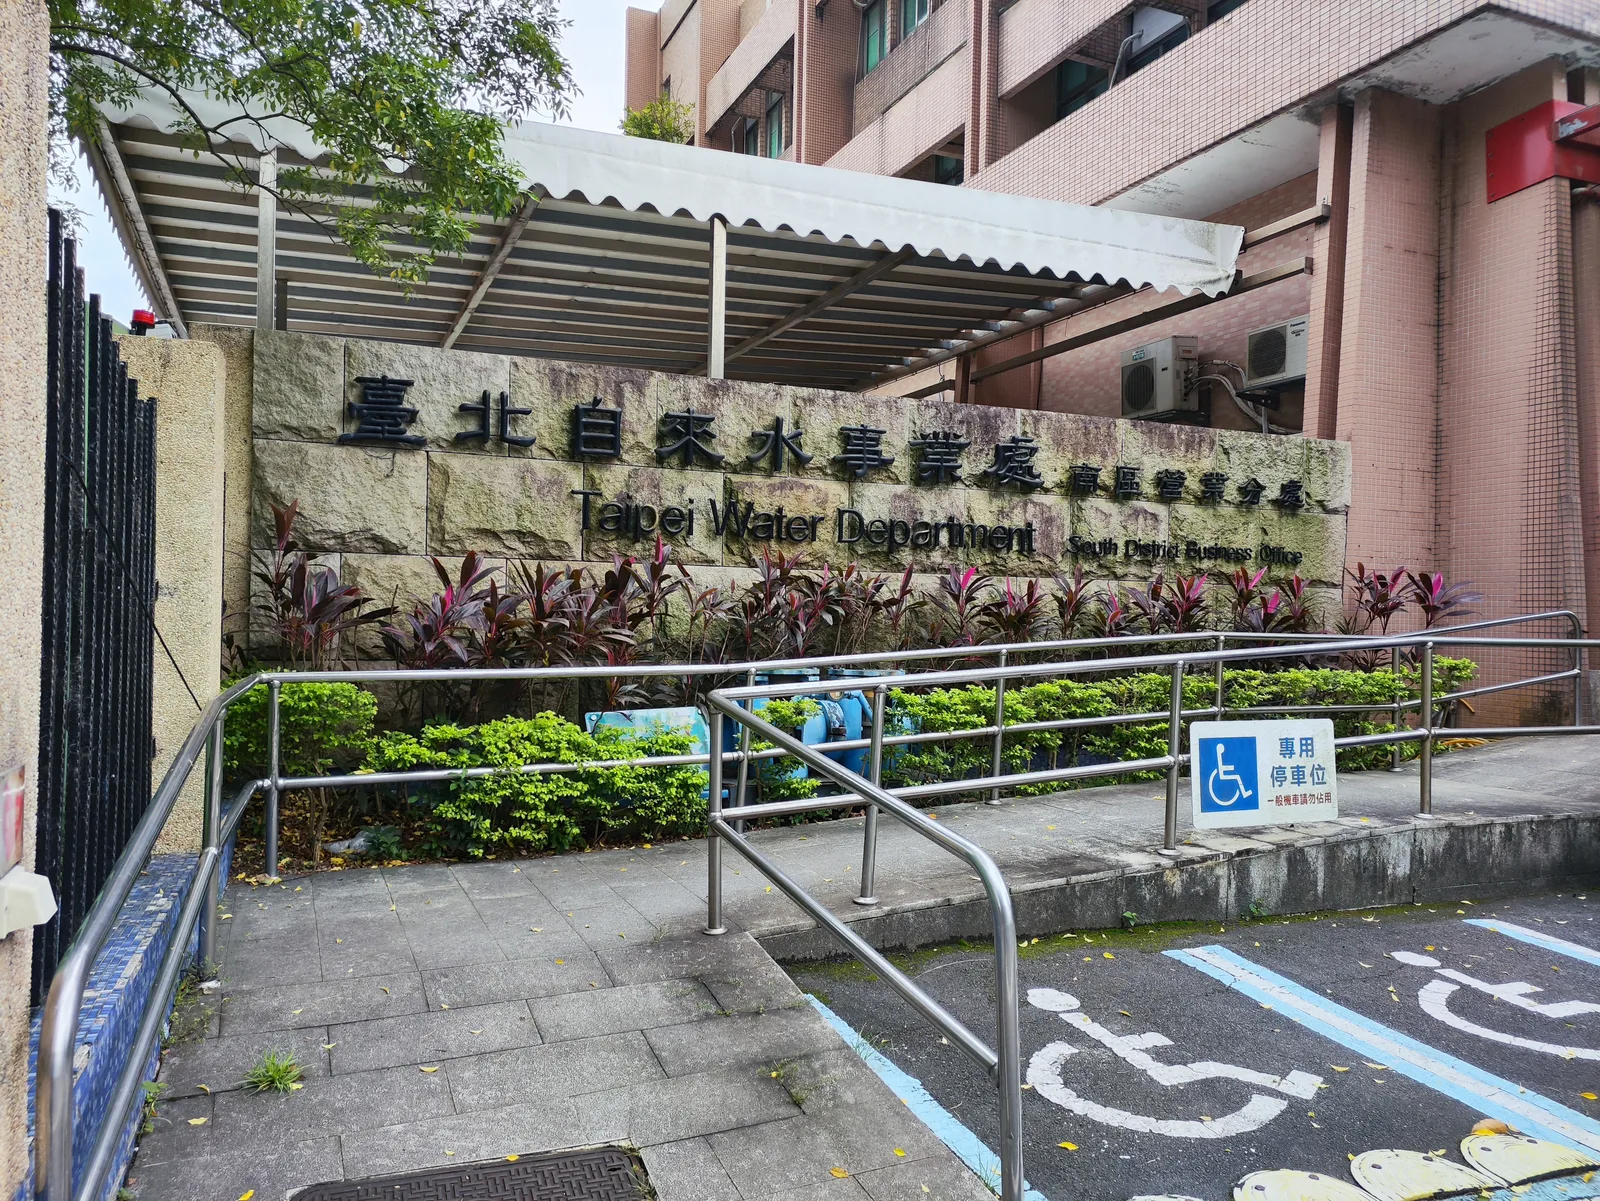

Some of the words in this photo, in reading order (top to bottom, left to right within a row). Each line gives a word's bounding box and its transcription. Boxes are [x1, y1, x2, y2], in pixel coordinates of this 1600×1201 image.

[337, 374, 1046, 489] 臺北自來水事業處
[1069, 462, 1306, 509] 南區營業分處
[571, 489, 694, 542] Taipei
[709, 497, 825, 543] Water
[837, 508, 1038, 552] Department
[1068, 535, 1118, 555] South
[1124, 538, 1180, 560] District
[1185, 540, 1252, 562] Business
[1259, 543, 1303, 565] Office
[1278, 737, 1315, 759] 專用
[1270, 763, 1327, 788] 停車位
[1267, 792, 1332, 807] 一般機車請勿佔用
